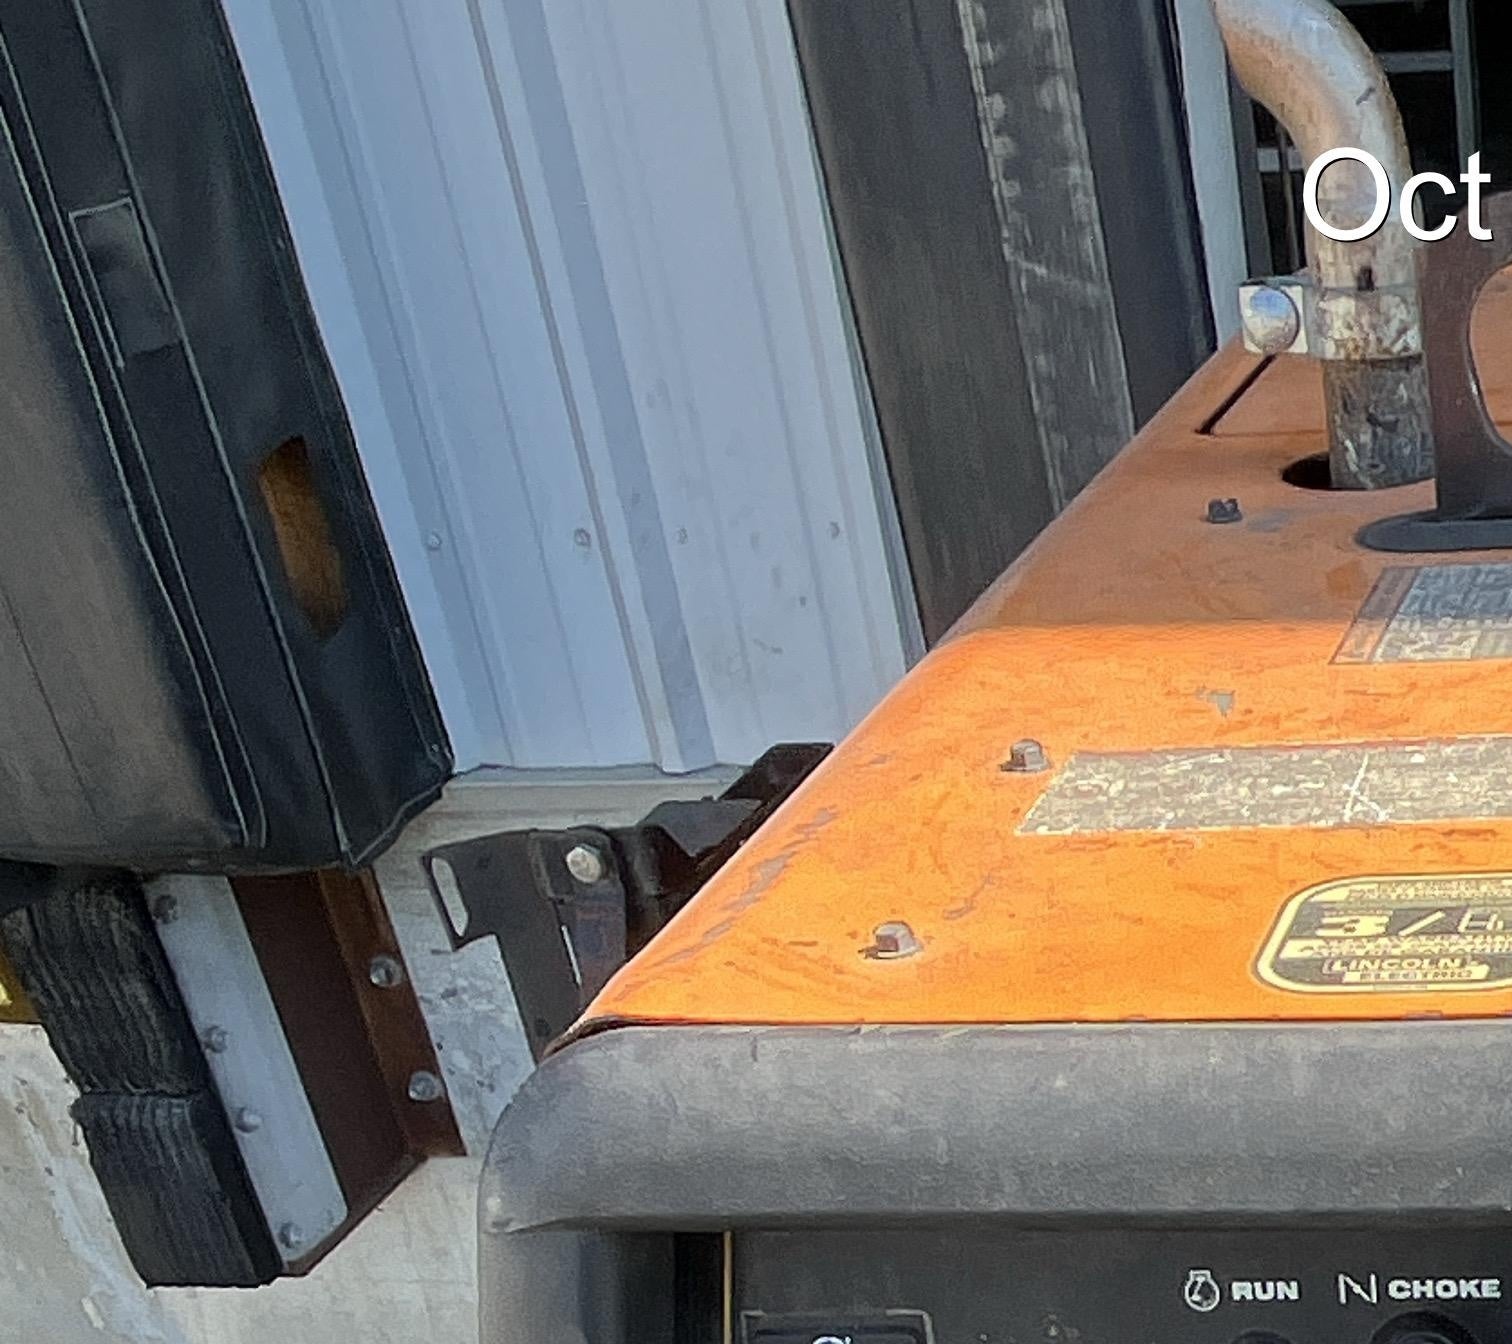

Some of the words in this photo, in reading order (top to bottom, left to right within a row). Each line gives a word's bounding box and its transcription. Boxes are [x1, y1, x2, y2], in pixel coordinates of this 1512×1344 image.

[1335, 958, 1462, 971] LINCOLN
[1231, 1280, 1299, 1301] RUN
[1388, 1278, 1502, 1300] CHOKE
